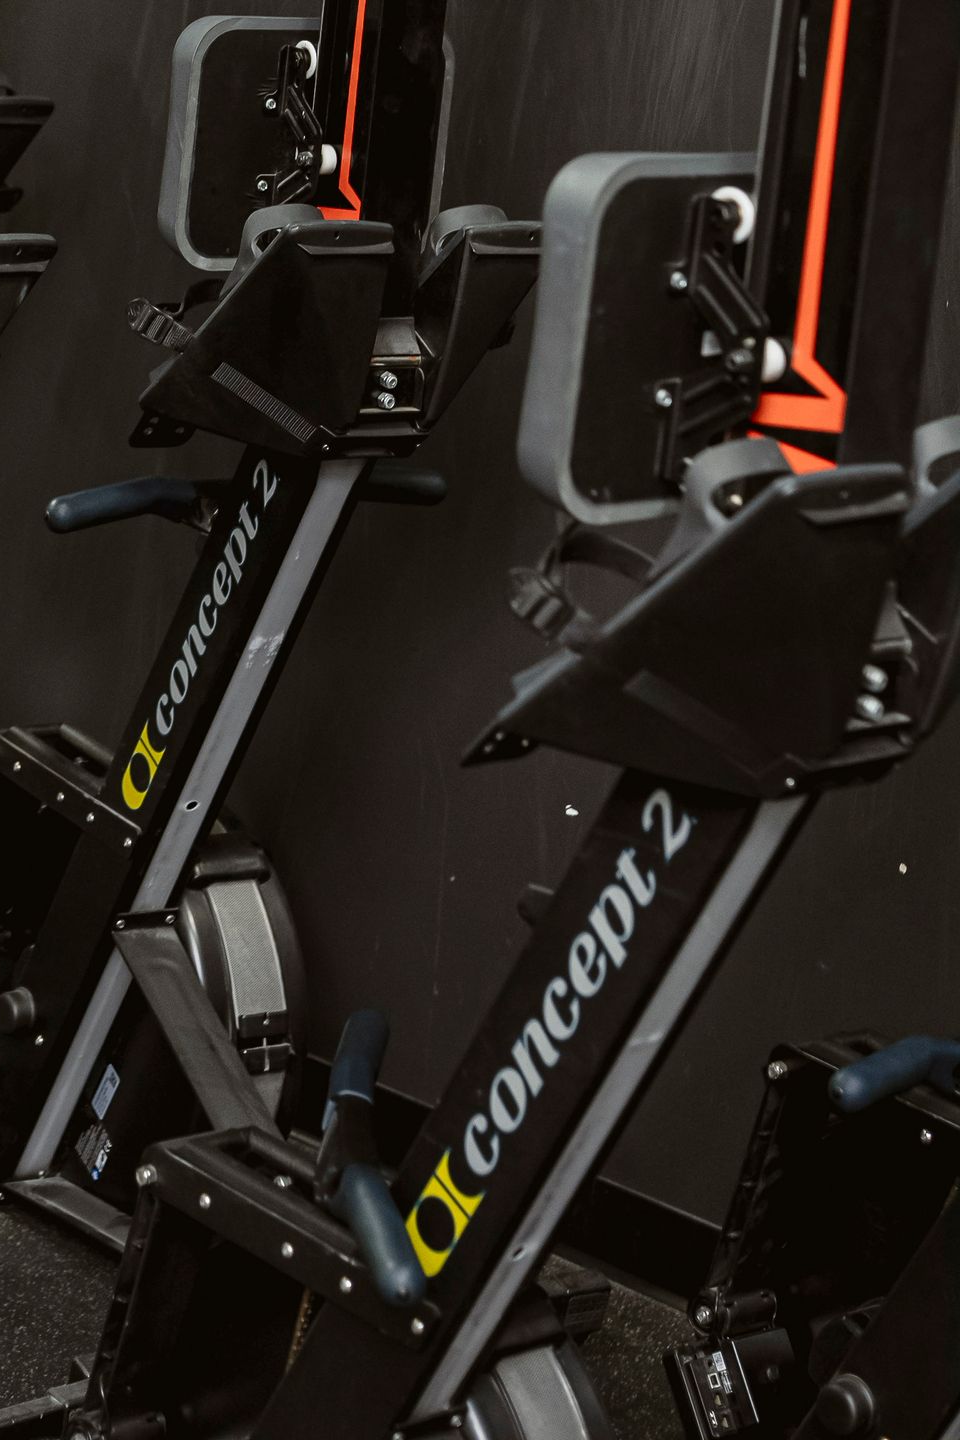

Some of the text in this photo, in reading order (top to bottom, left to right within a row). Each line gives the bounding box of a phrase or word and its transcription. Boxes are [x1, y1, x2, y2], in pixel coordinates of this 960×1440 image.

[156, 459, 278, 736] concept 2
[463, 788, 692, 1177] concept 2
